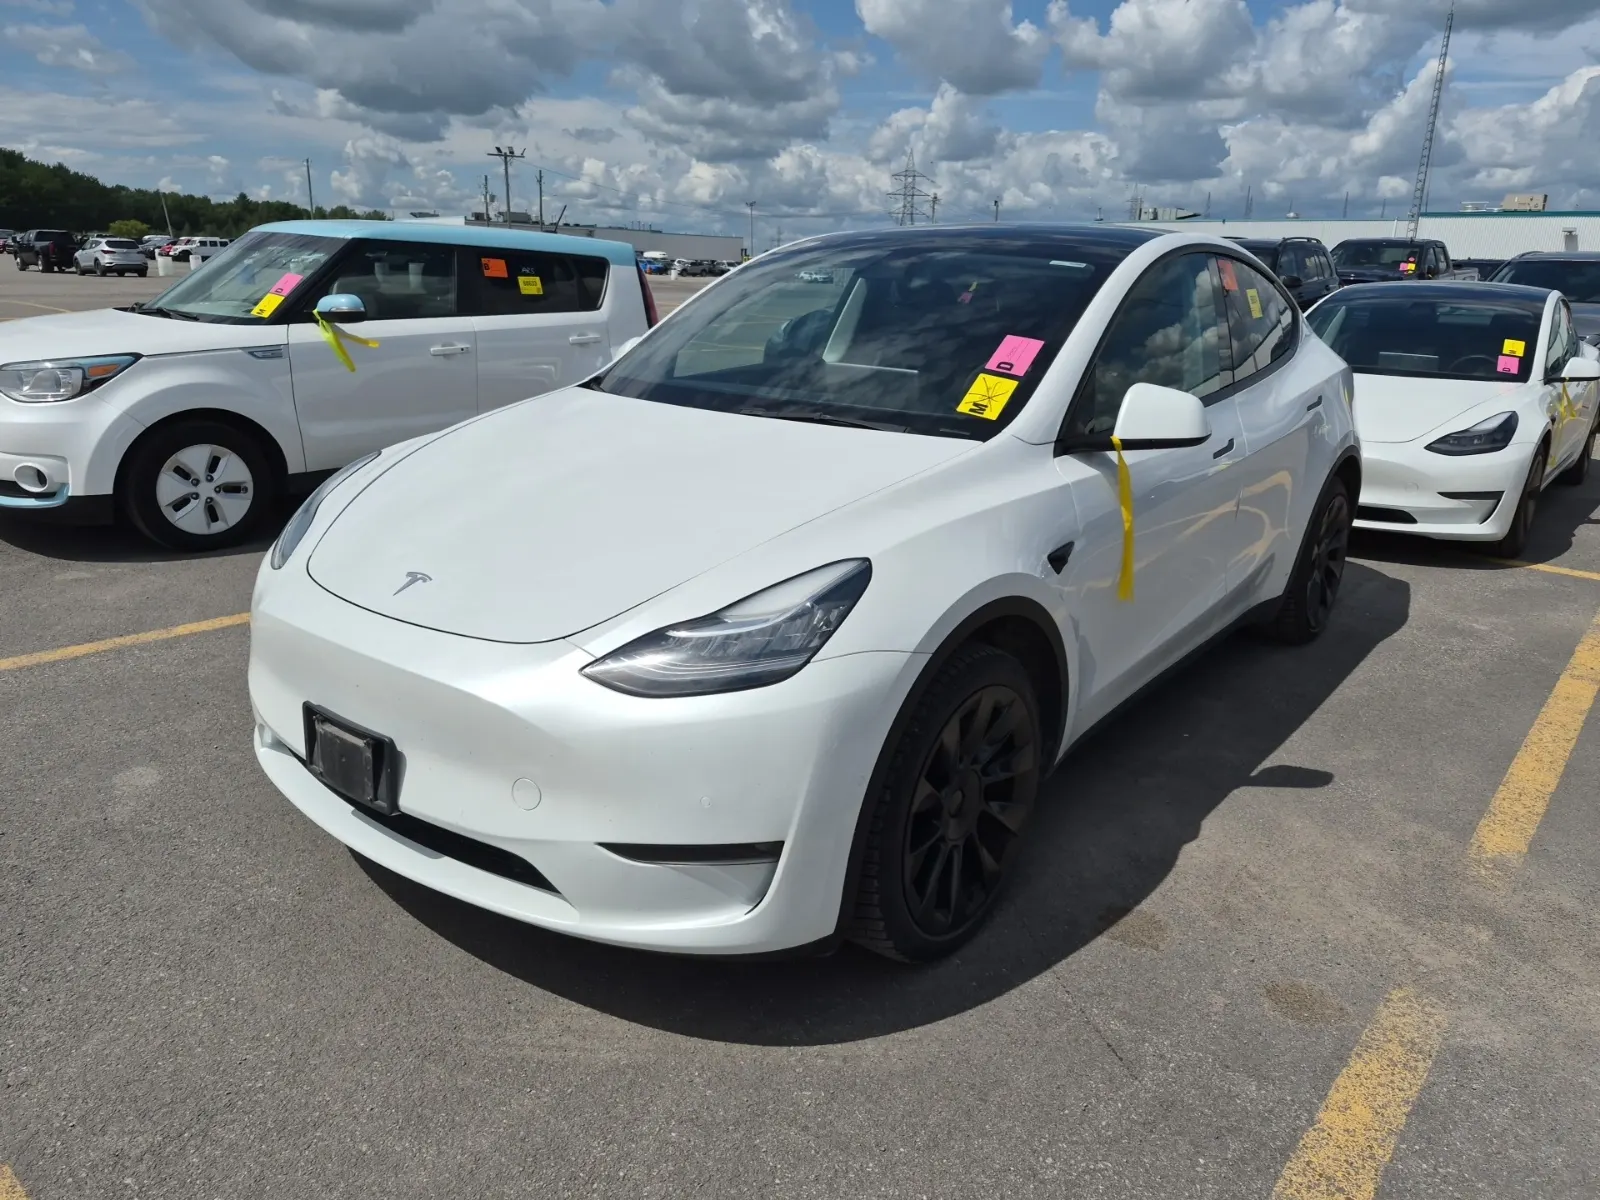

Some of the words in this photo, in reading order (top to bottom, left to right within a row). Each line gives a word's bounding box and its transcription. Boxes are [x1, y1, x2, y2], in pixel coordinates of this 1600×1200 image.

[484, 263, 490, 271] B
[996, 361, 1014, 371] D
[968, 402, 988, 415] M
